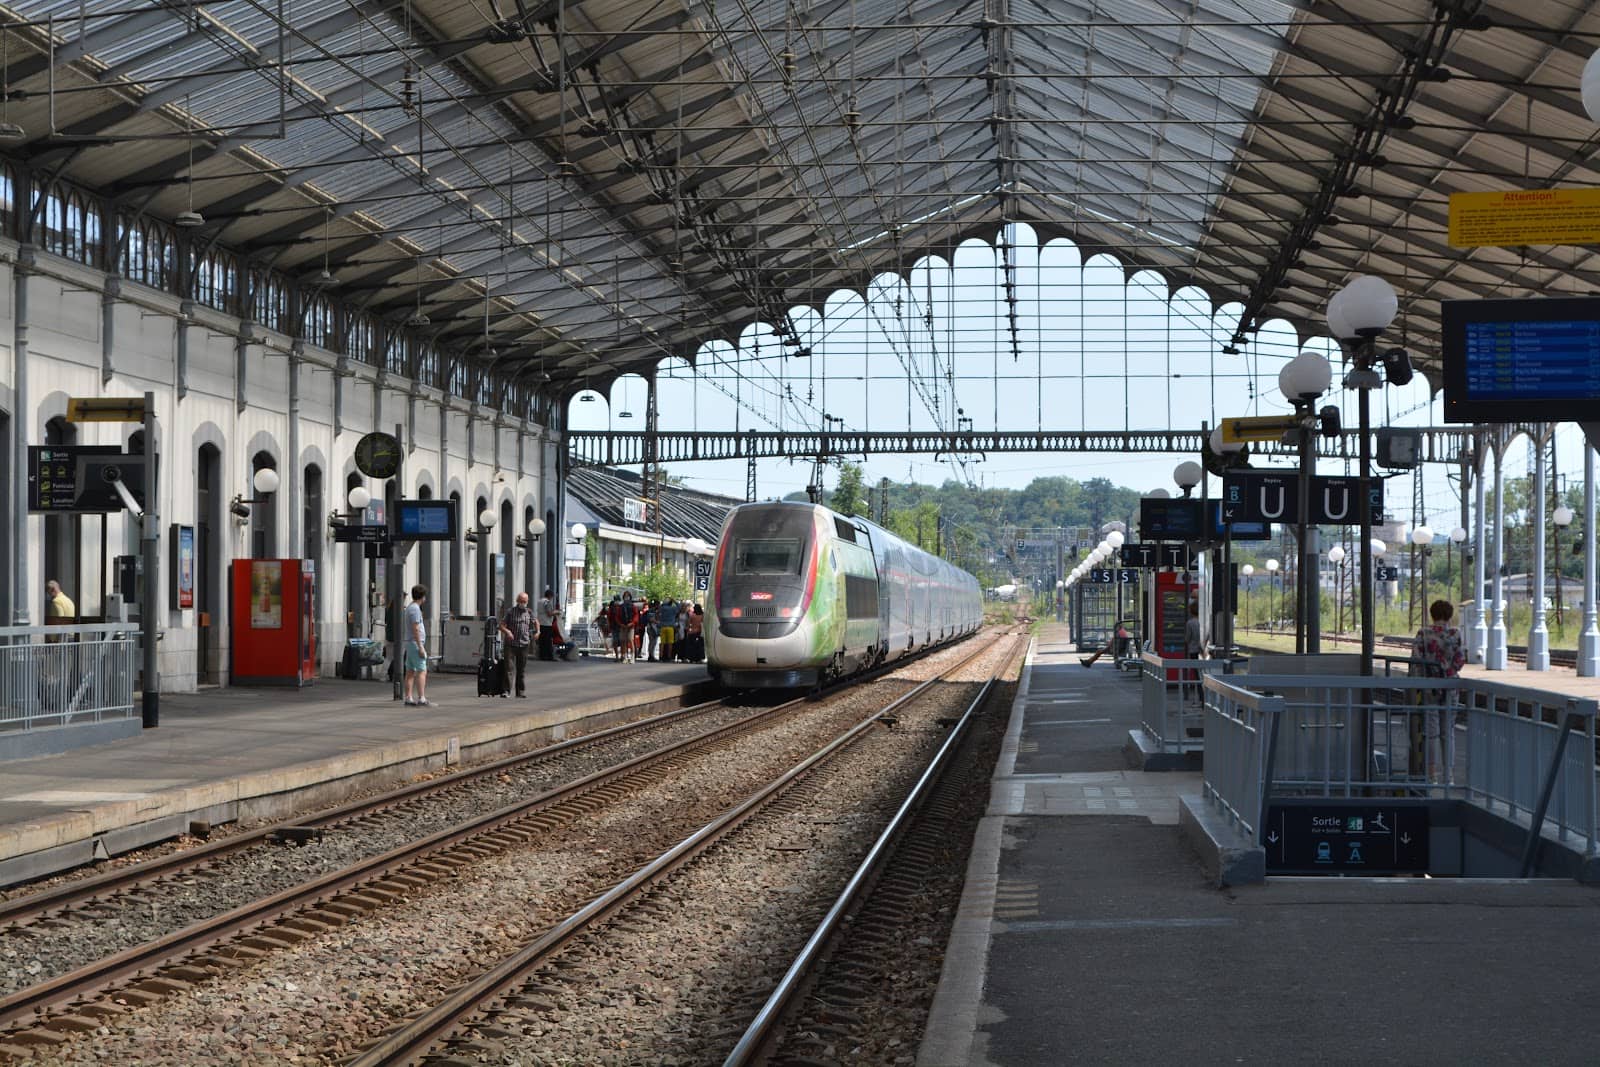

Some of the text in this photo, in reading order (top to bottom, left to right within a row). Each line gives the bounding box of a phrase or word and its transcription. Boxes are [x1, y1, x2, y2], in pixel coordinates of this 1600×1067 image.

[1503, 191, 1552, 201] Attention
[1231, 490, 1239, 501] B
[1260, 486, 1285, 519] U
[1324, 487, 1349, 520] U
[1140, 549, 1151, 565] T
[1169, 549, 1180, 565] T
[697, 563, 710, 575] 5V
[1380, 569, 1388, 580] S
[1103, 572, 1110, 582] S
[1122, 572, 1129, 582] S
[700, 579, 707, 590] S
[1312, 816, 1341, 826] Sortie
[1350, 848, 1361, 860] A
